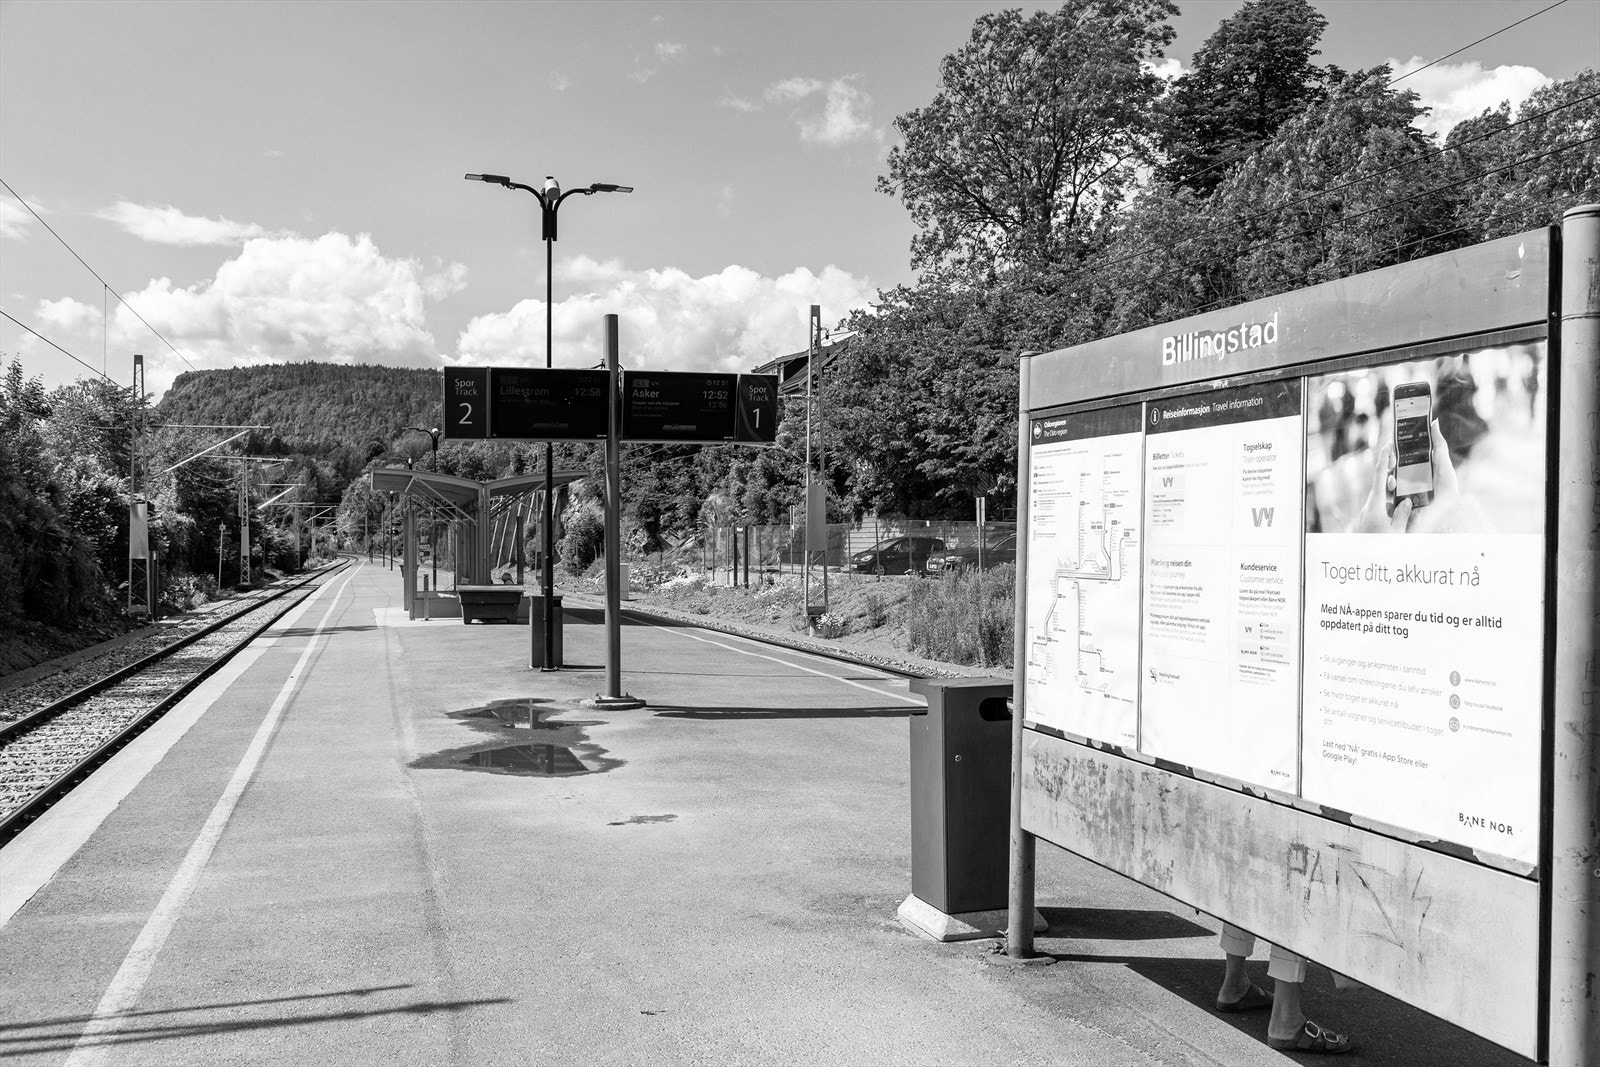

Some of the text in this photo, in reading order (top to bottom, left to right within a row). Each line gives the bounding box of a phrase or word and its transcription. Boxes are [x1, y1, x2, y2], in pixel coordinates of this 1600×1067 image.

[1162, 311, 1279, 366] Billingstad
[454, 378, 475, 389] Spor
[748, 385, 767, 394] Spor
[455, 388, 478, 396] Track
[500, 386, 601, 397] Lillestrøm 12:58
[632, 389, 729, 400] Asker 12:52
[749, 393, 769, 402] Track
[708, 401, 728, 409] 12:56
[1162, 396, 1263, 419] Reiseinformasjon Travel information
[458, 402, 473, 425] 2
[752, 408, 760, 429] 1
[1057, 429, 1068, 437] region
[1243, 442, 1273, 453] Togselskap
[1153, 453, 1170, 461] Billetter
[1243, 454, 1277, 463] Train operator
[1184, 559, 1193, 567] din
[1240, 563, 1278, 572] Kundeservice
[1239, 574, 1284, 584] Customer service
[1321, 562, 1481, 587] Toget ditt, akkurat nå
[1320, 604, 1502, 629] Med NÅ-appen sparer du tid og er alltid
[1320, 620, 1409, 639] oppdatert på ditt tog
[1324, 654, 1331, 662] Se
[1357, 660, 1366, 670] og
[1366, 661, 1399, 672] ankomster
[1402, 666, 1427, 675] sanntid
[1323, 671, 1331, 680] Få
[1331, 673, 1348, 683] varsel
[1358, 676, 1397, 691] strekningene
[1397, 683, 1407, 691] du
[1407, 684, 1420, 693] selv
[1420, 687, 1443, 696] ønsker
[1323, 689, 1331, 697] Se
[1331, 690, 1345, 699] hvor
[1344, 693, 1361, 703] toget
[1368, 696, 1389, 708] akkurat
[1390, 700, 1399, 709] nå
[1323, 706, 1331, 714] Se
[1331, 708, 1346, 717] antall
[1346, 711, 1367, 722] vogner
[1368, 715, 1377, 725] og
[1377, 716, 1422, 732] servicetilbudet
[1426, 726, 1444, 737] toget
[1322, 739, 1334, 750] Last
[1334, 742, 1346, 751] ned
[1361, 746, 1378, 758] gratis
[1382, 751, 1396, 763] App
[1397, 755, 1414, 767] Store
[1414, 758, 1429, 770] eller
[1322, 750, 1343, 763] Google
[1458, 813, 1514, 837] BANE NOR
